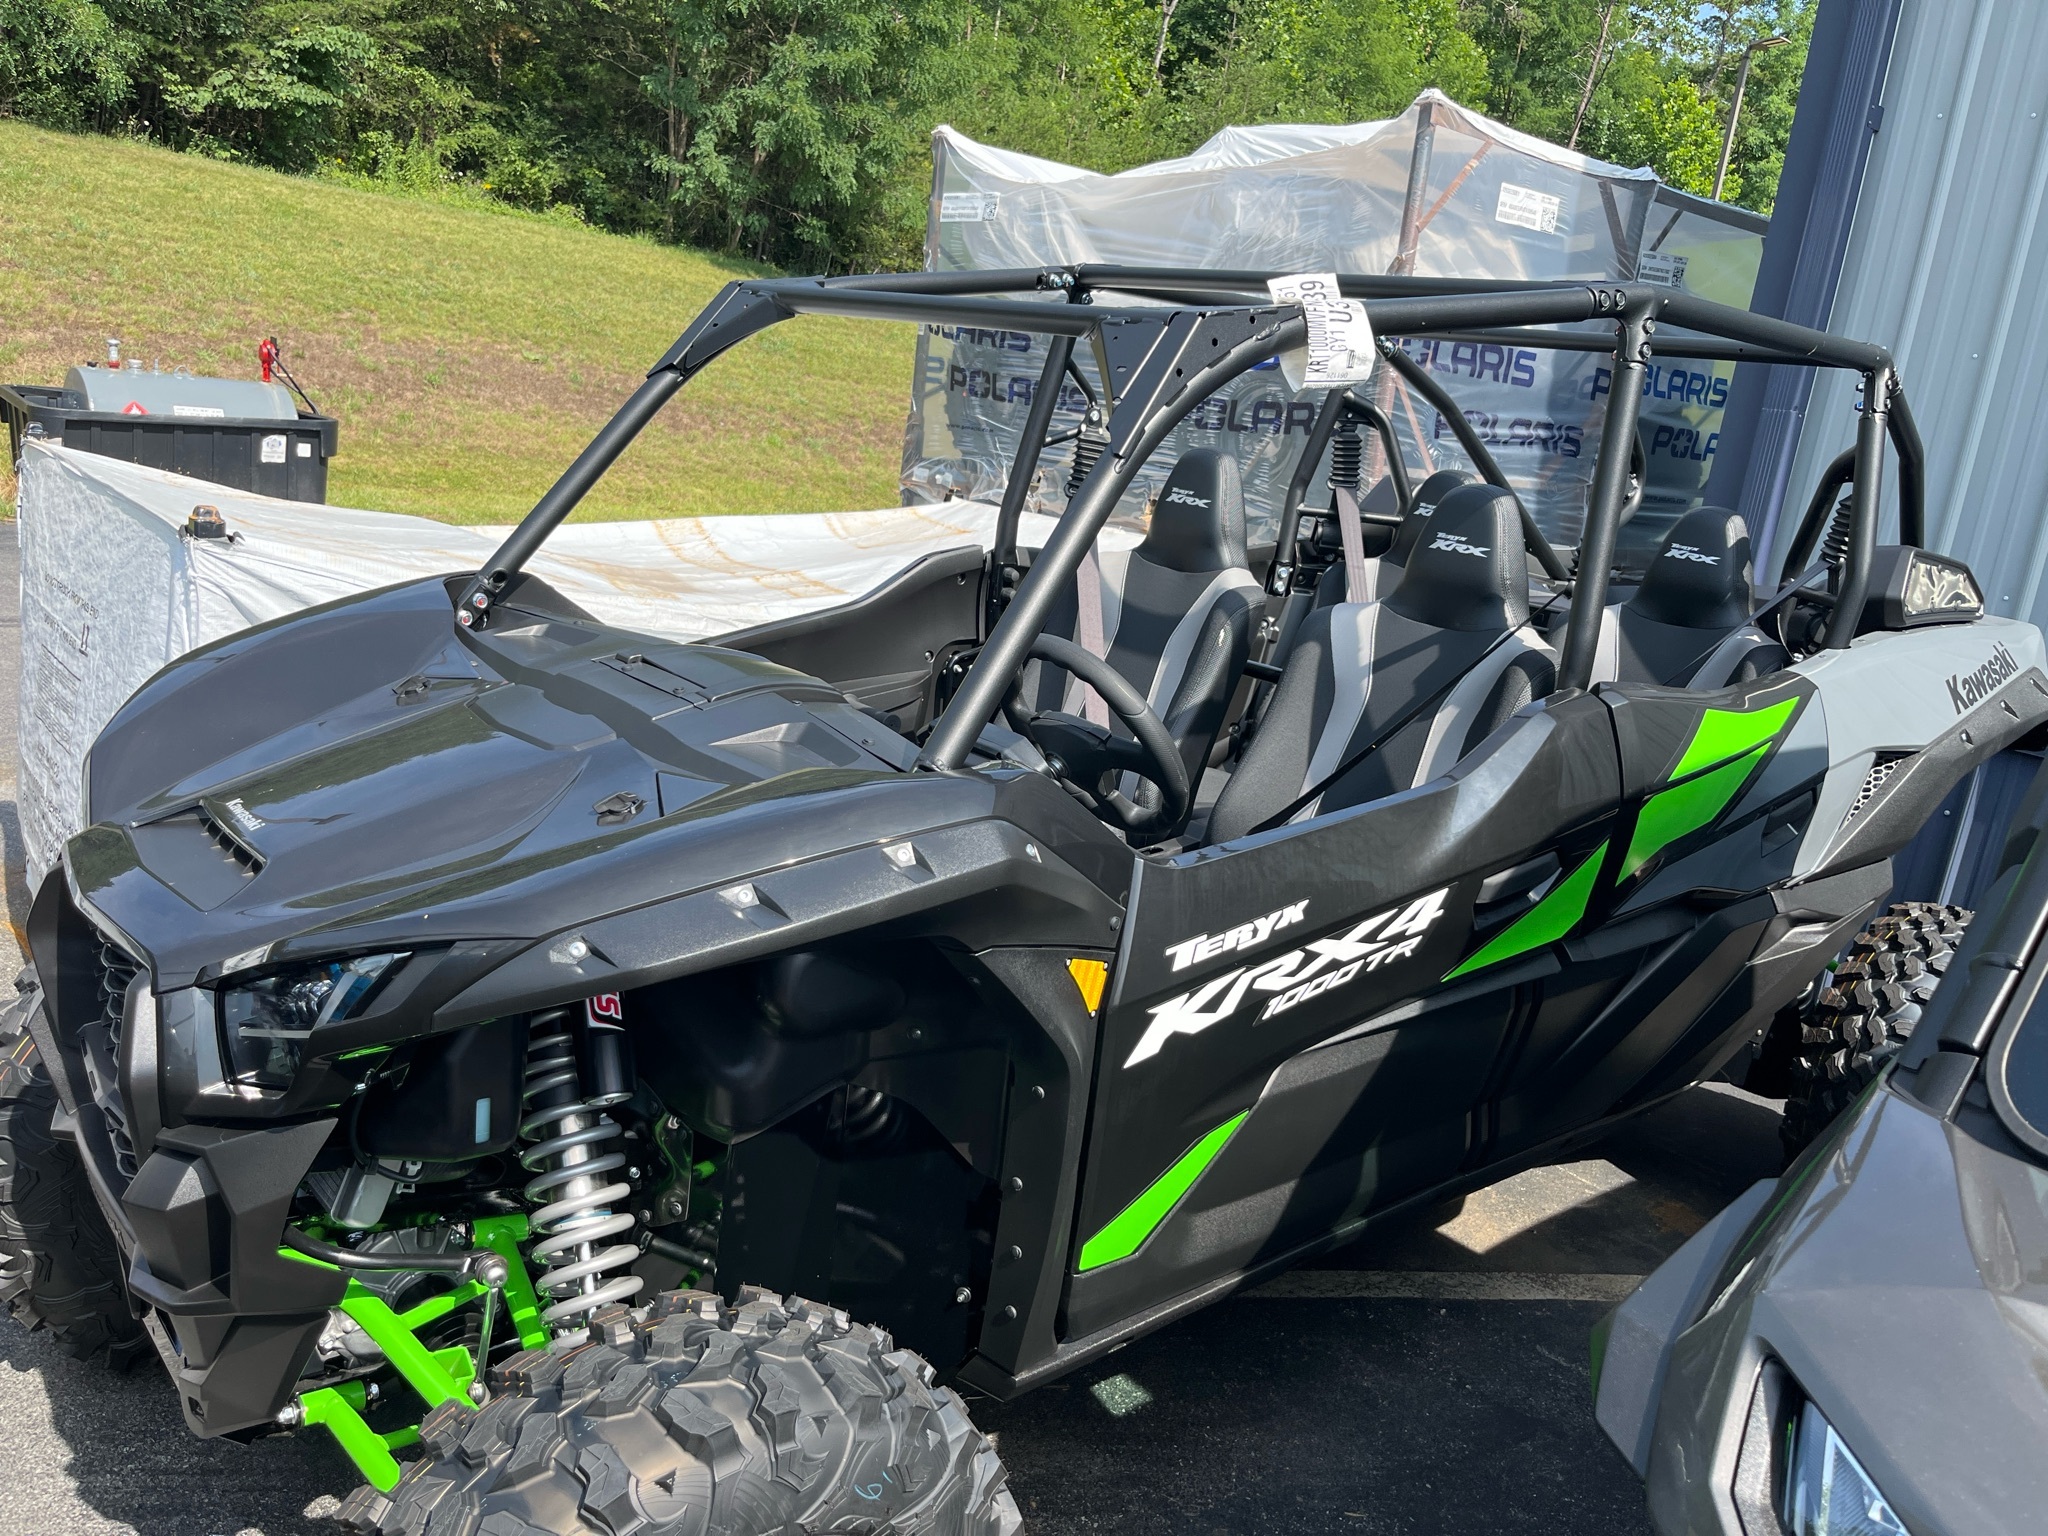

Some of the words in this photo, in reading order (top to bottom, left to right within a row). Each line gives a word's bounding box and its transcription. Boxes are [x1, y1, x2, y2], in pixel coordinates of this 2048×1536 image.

[1392, 337, 1537, 388] OLARIS
[950, 364, 1088, 415] POLAIS
[1428, 538, 1491, 558] KRX
[1663, 548, 1721, 566] KRX
[1945, 640, 2019, 715] Kawasaki
[225, 797, 266, 831] Kawasaki
[1122, 887, 1450, 1070] KRX4
